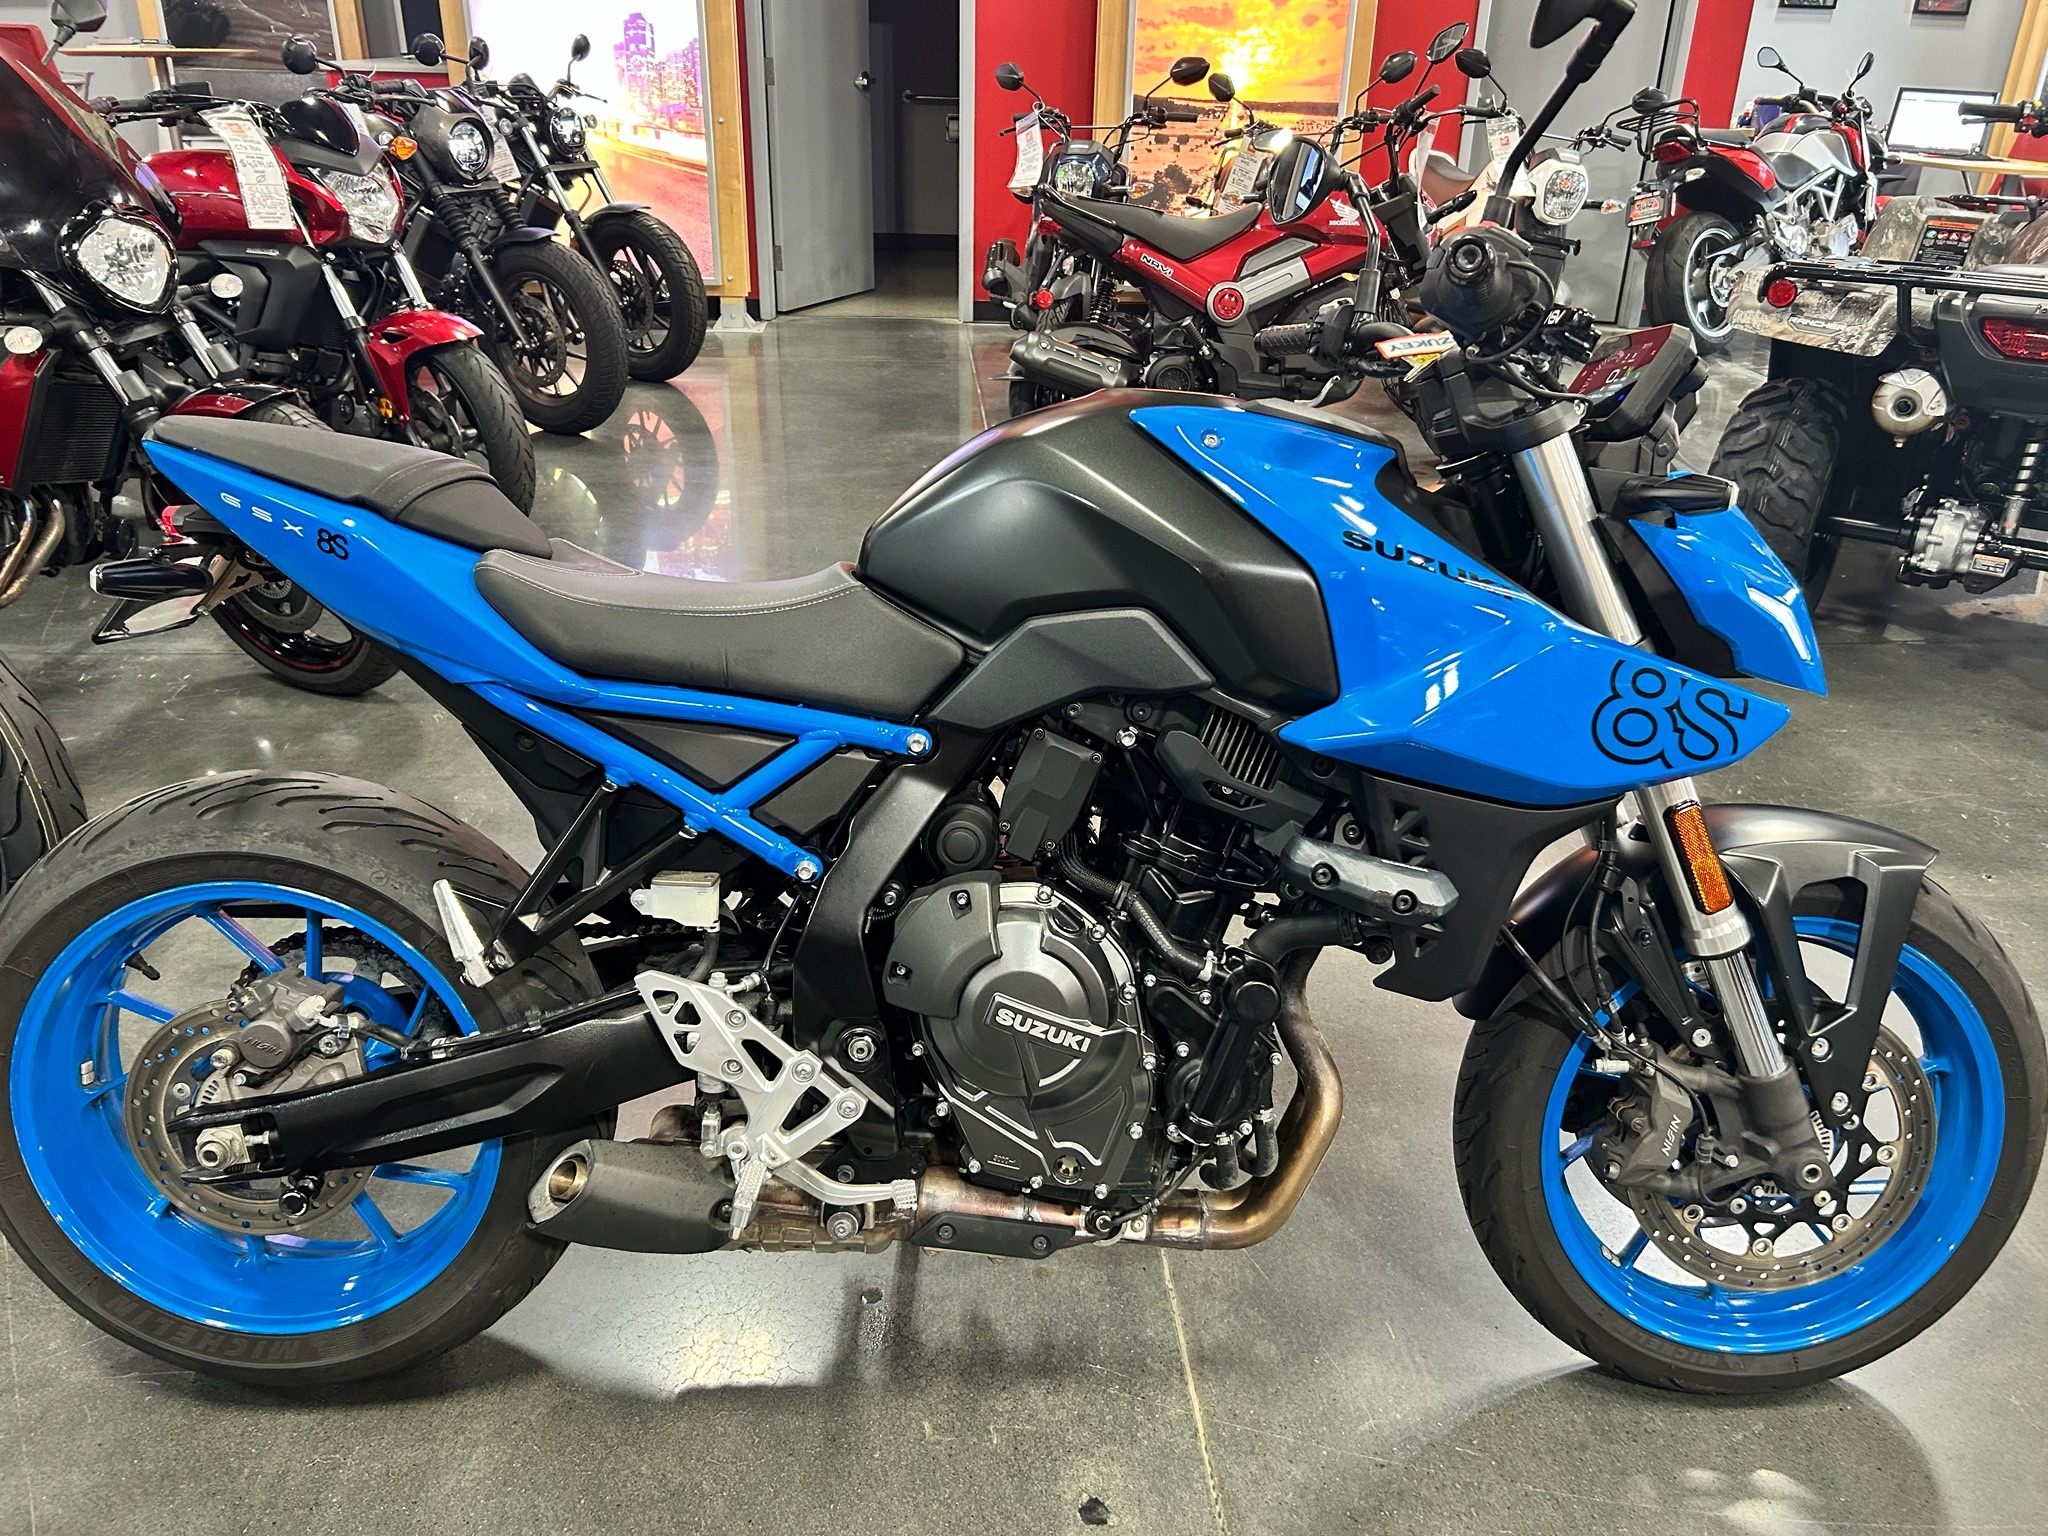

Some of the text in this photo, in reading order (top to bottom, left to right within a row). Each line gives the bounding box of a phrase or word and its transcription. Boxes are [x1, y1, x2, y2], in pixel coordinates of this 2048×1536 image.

[1328, 219, 1361, 227] HONDA
[1140, 252, 1174, 277] NAVI
[1788, 316, 1848, 331] RANCHER
[220, 492, 349, 560] GSX 8S
[1341, 530, 1513, 600] SUZUKI
[1591, 658, 1749, 769] 8S
[995, 1008, 1092, 1053] SUZUKI
[103, 1293, 302, 1361] MICHELIN
